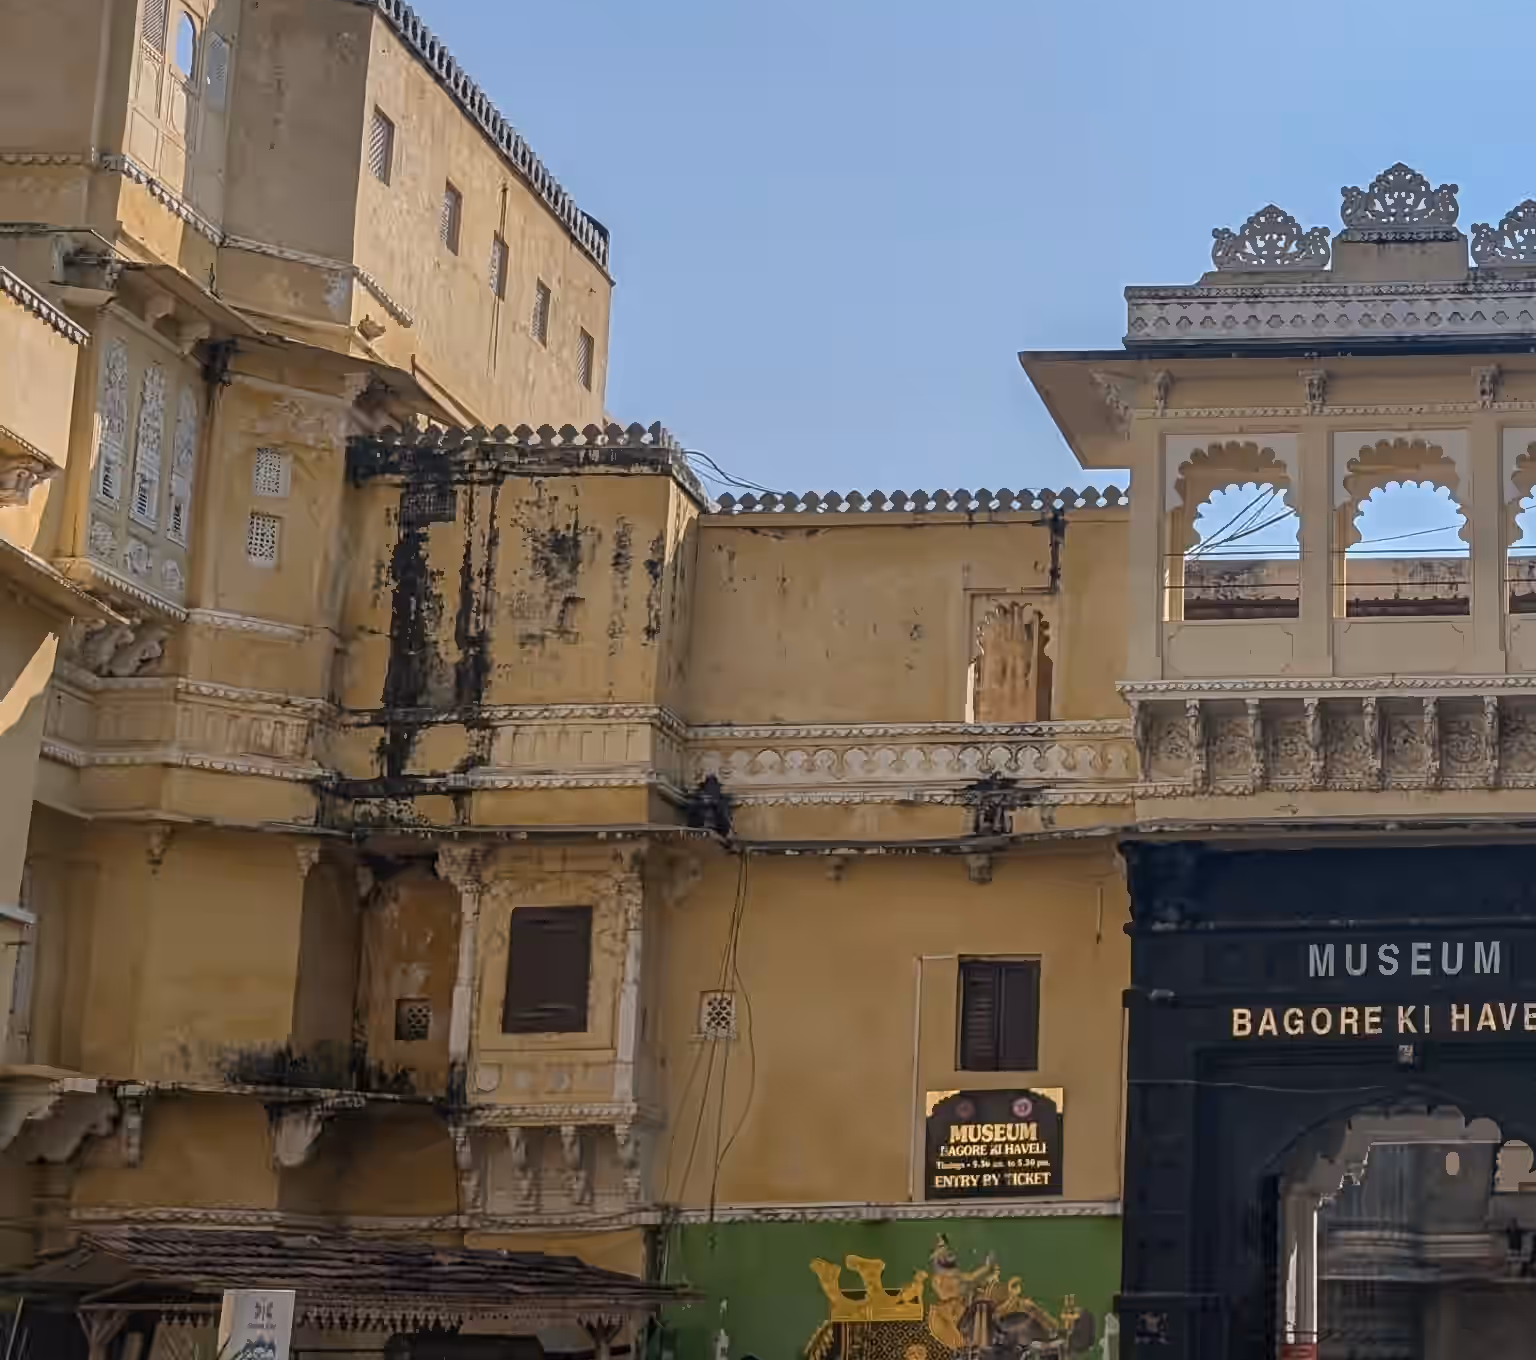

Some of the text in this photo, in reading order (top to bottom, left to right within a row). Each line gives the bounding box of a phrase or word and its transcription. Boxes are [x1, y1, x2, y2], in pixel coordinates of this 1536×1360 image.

[1309, 941, 1500, 977] MUSEUM
[1232, 1006, 1382, 1036] BAGORE
[1398, 1005, 1430, 1033] KI
[950, 1122, 1038, 1143] MUSEUM
[1005, 1142, 1046, 1155] HAVELI
[935, 1174, 981, 1188] ENTRY
[1003, 1172, 1051, 1185] TICKET
